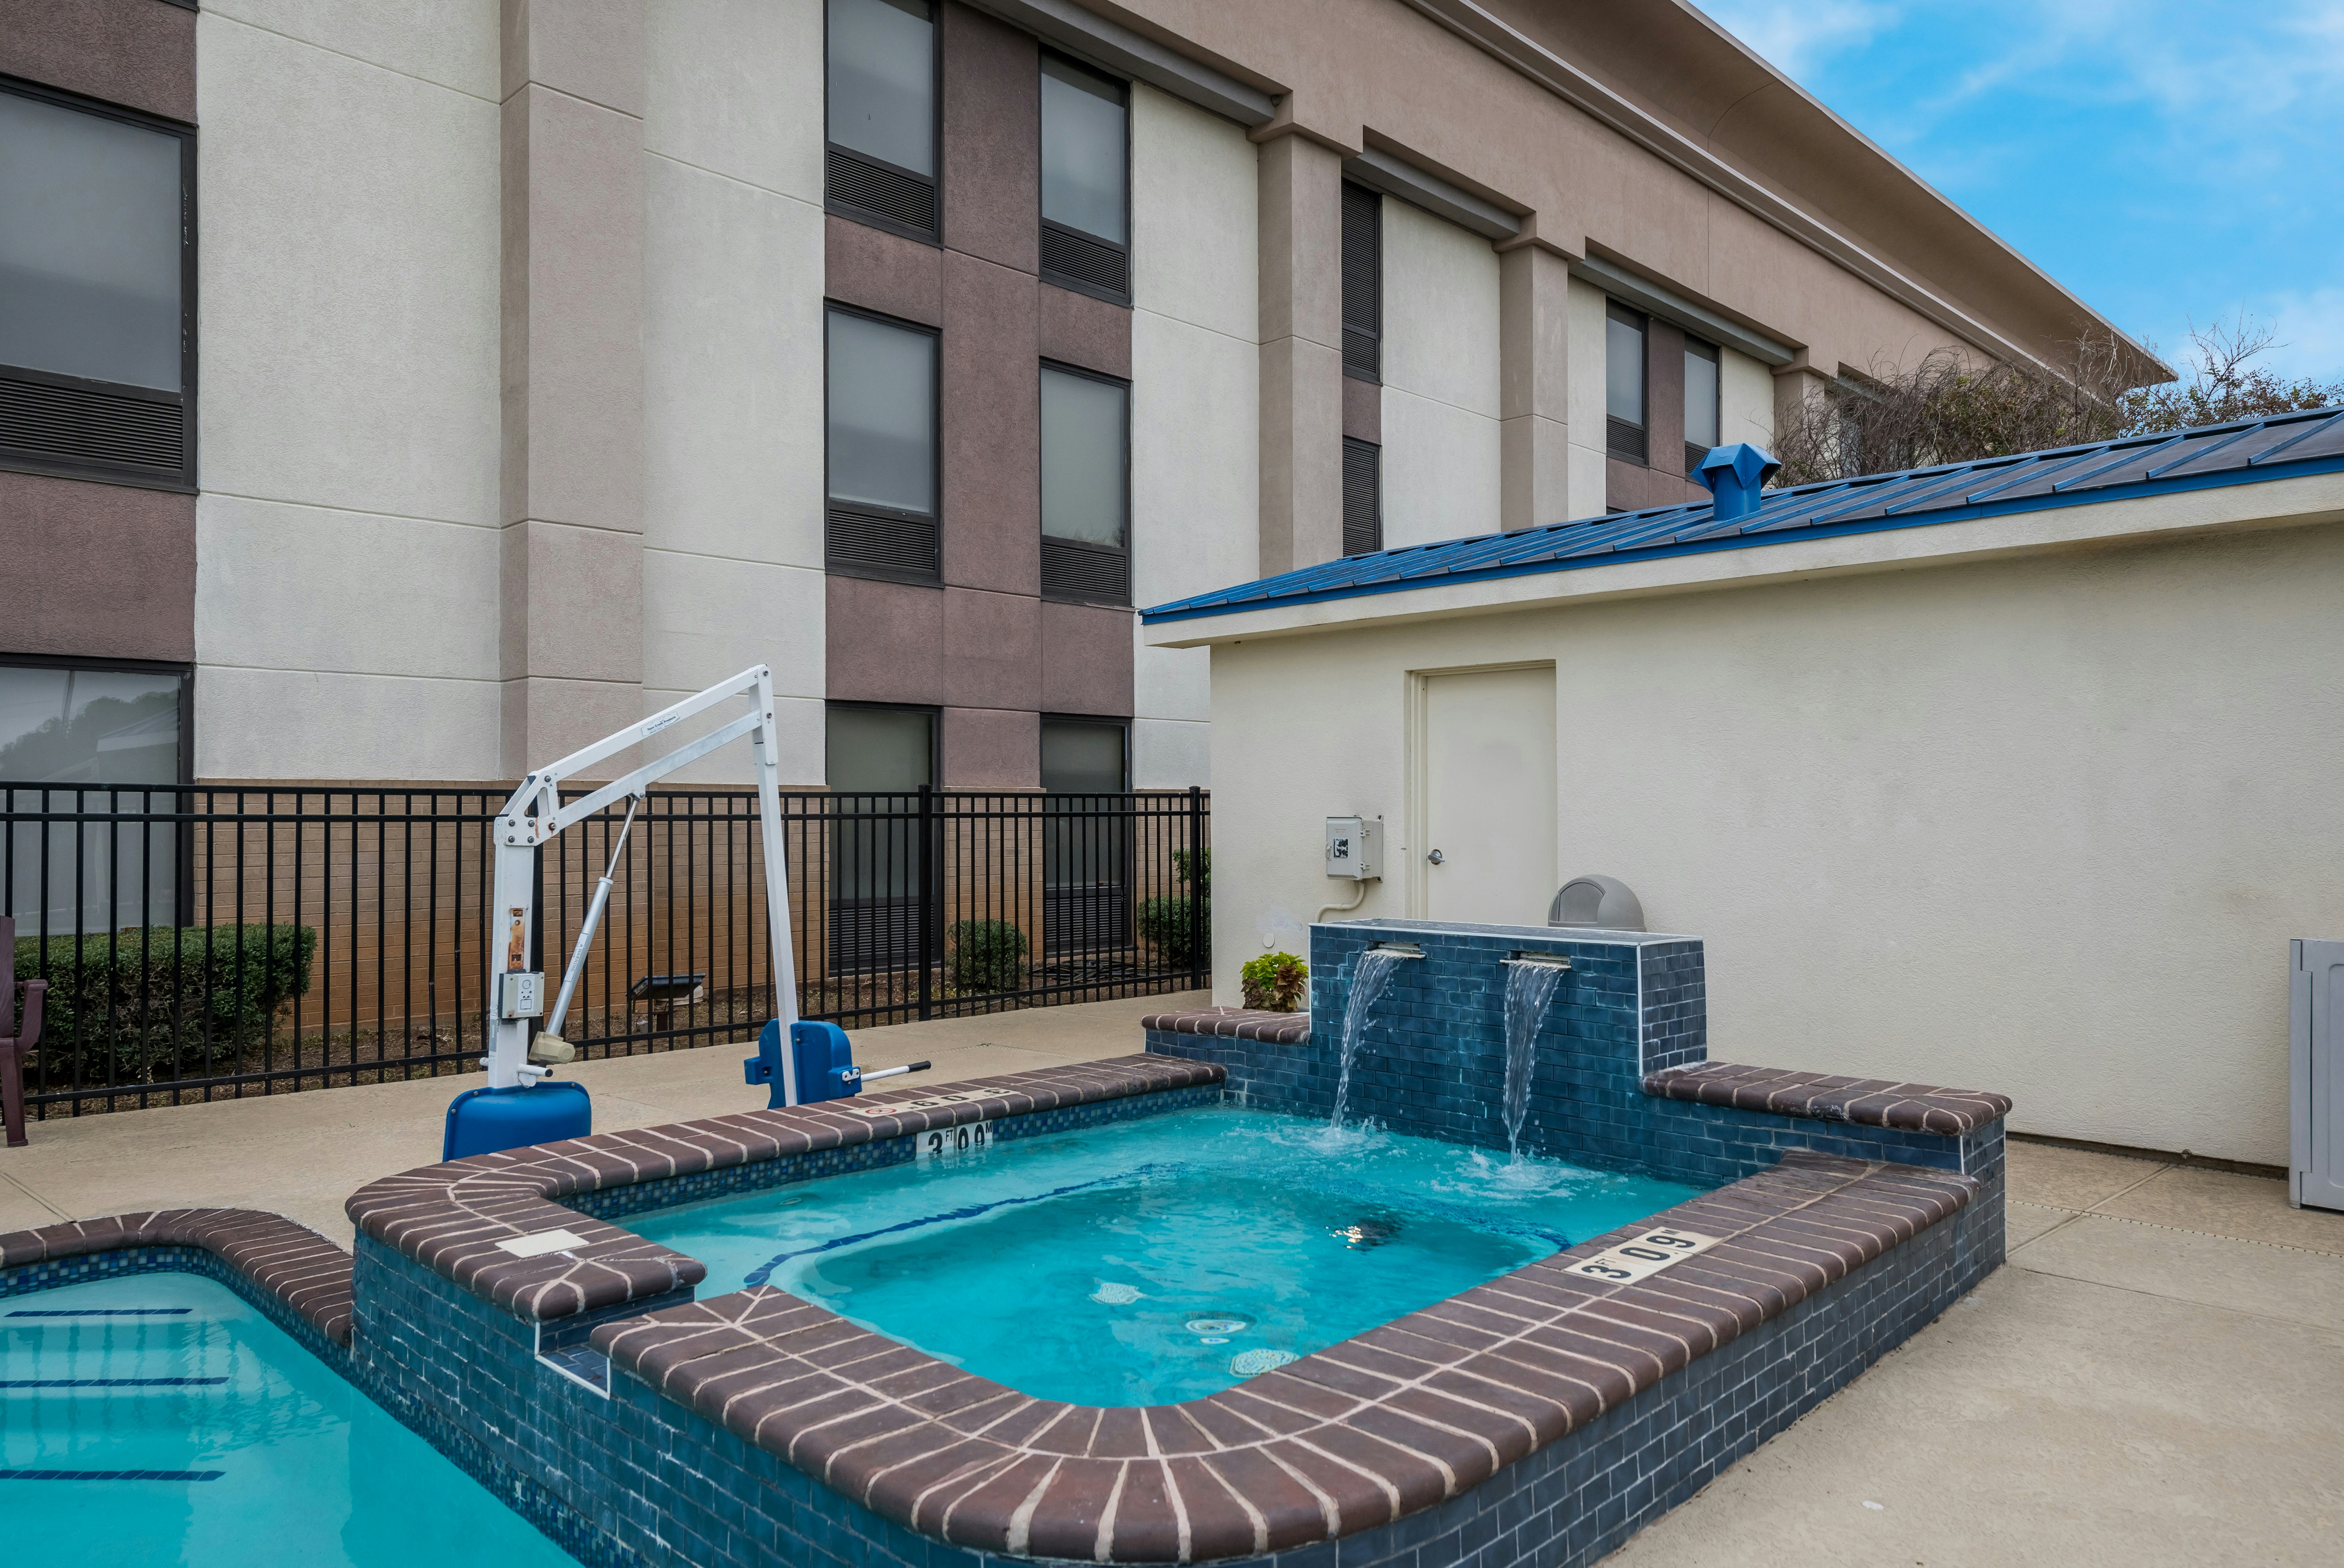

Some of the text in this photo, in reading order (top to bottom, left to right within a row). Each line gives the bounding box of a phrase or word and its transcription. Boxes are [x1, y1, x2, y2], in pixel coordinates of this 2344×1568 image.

[571, 948, 582, 972] WARNING
[928, 1132, 943, 1155] 3
[946, 1129, 954, 1142] FT
[985, 1121, 992, 1134] M
[1595, 1258, 1616, 1266] FT
[1581, 1265, 1631, 1279] 3
